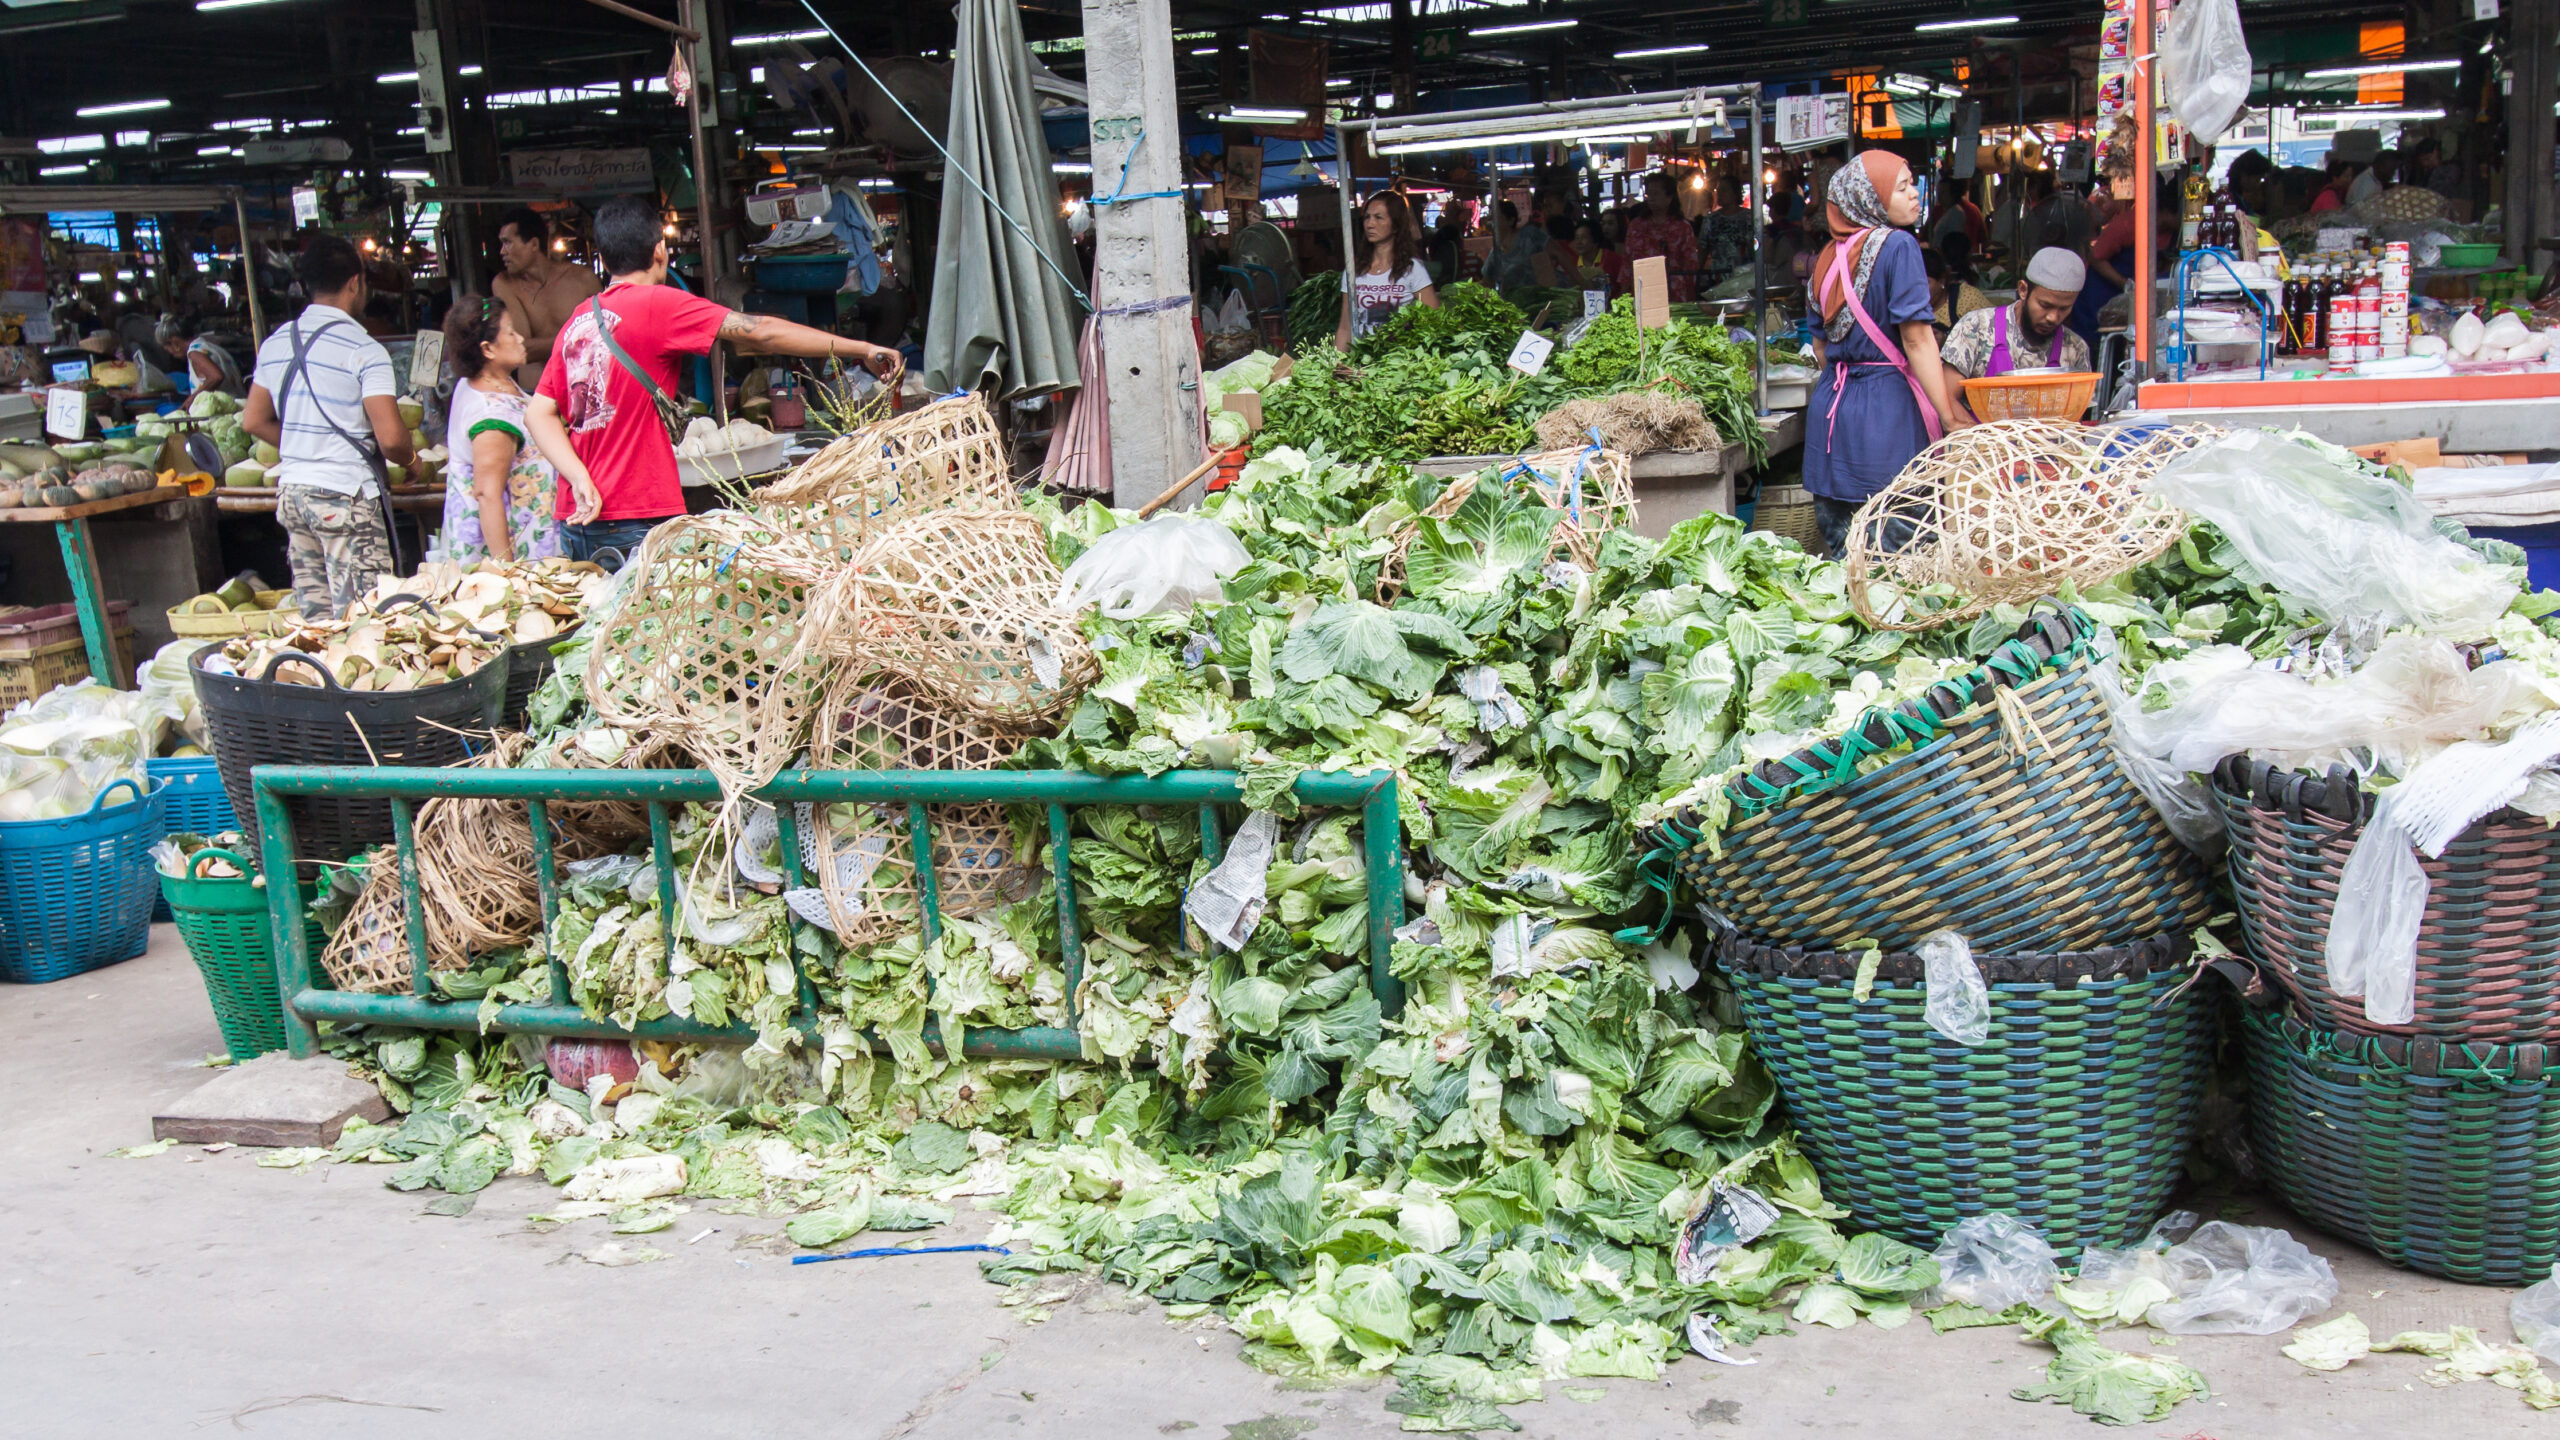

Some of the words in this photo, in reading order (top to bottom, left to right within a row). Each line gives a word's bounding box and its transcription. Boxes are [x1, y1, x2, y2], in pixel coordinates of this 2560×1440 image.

[1423, 34, 1451, 56] 24
[501, 119, 523, 137] 28
[1093, 115, 1143, 143] STC
[418, 335, 440, 372] 10
[1518, 340, 1541, 364] 6
